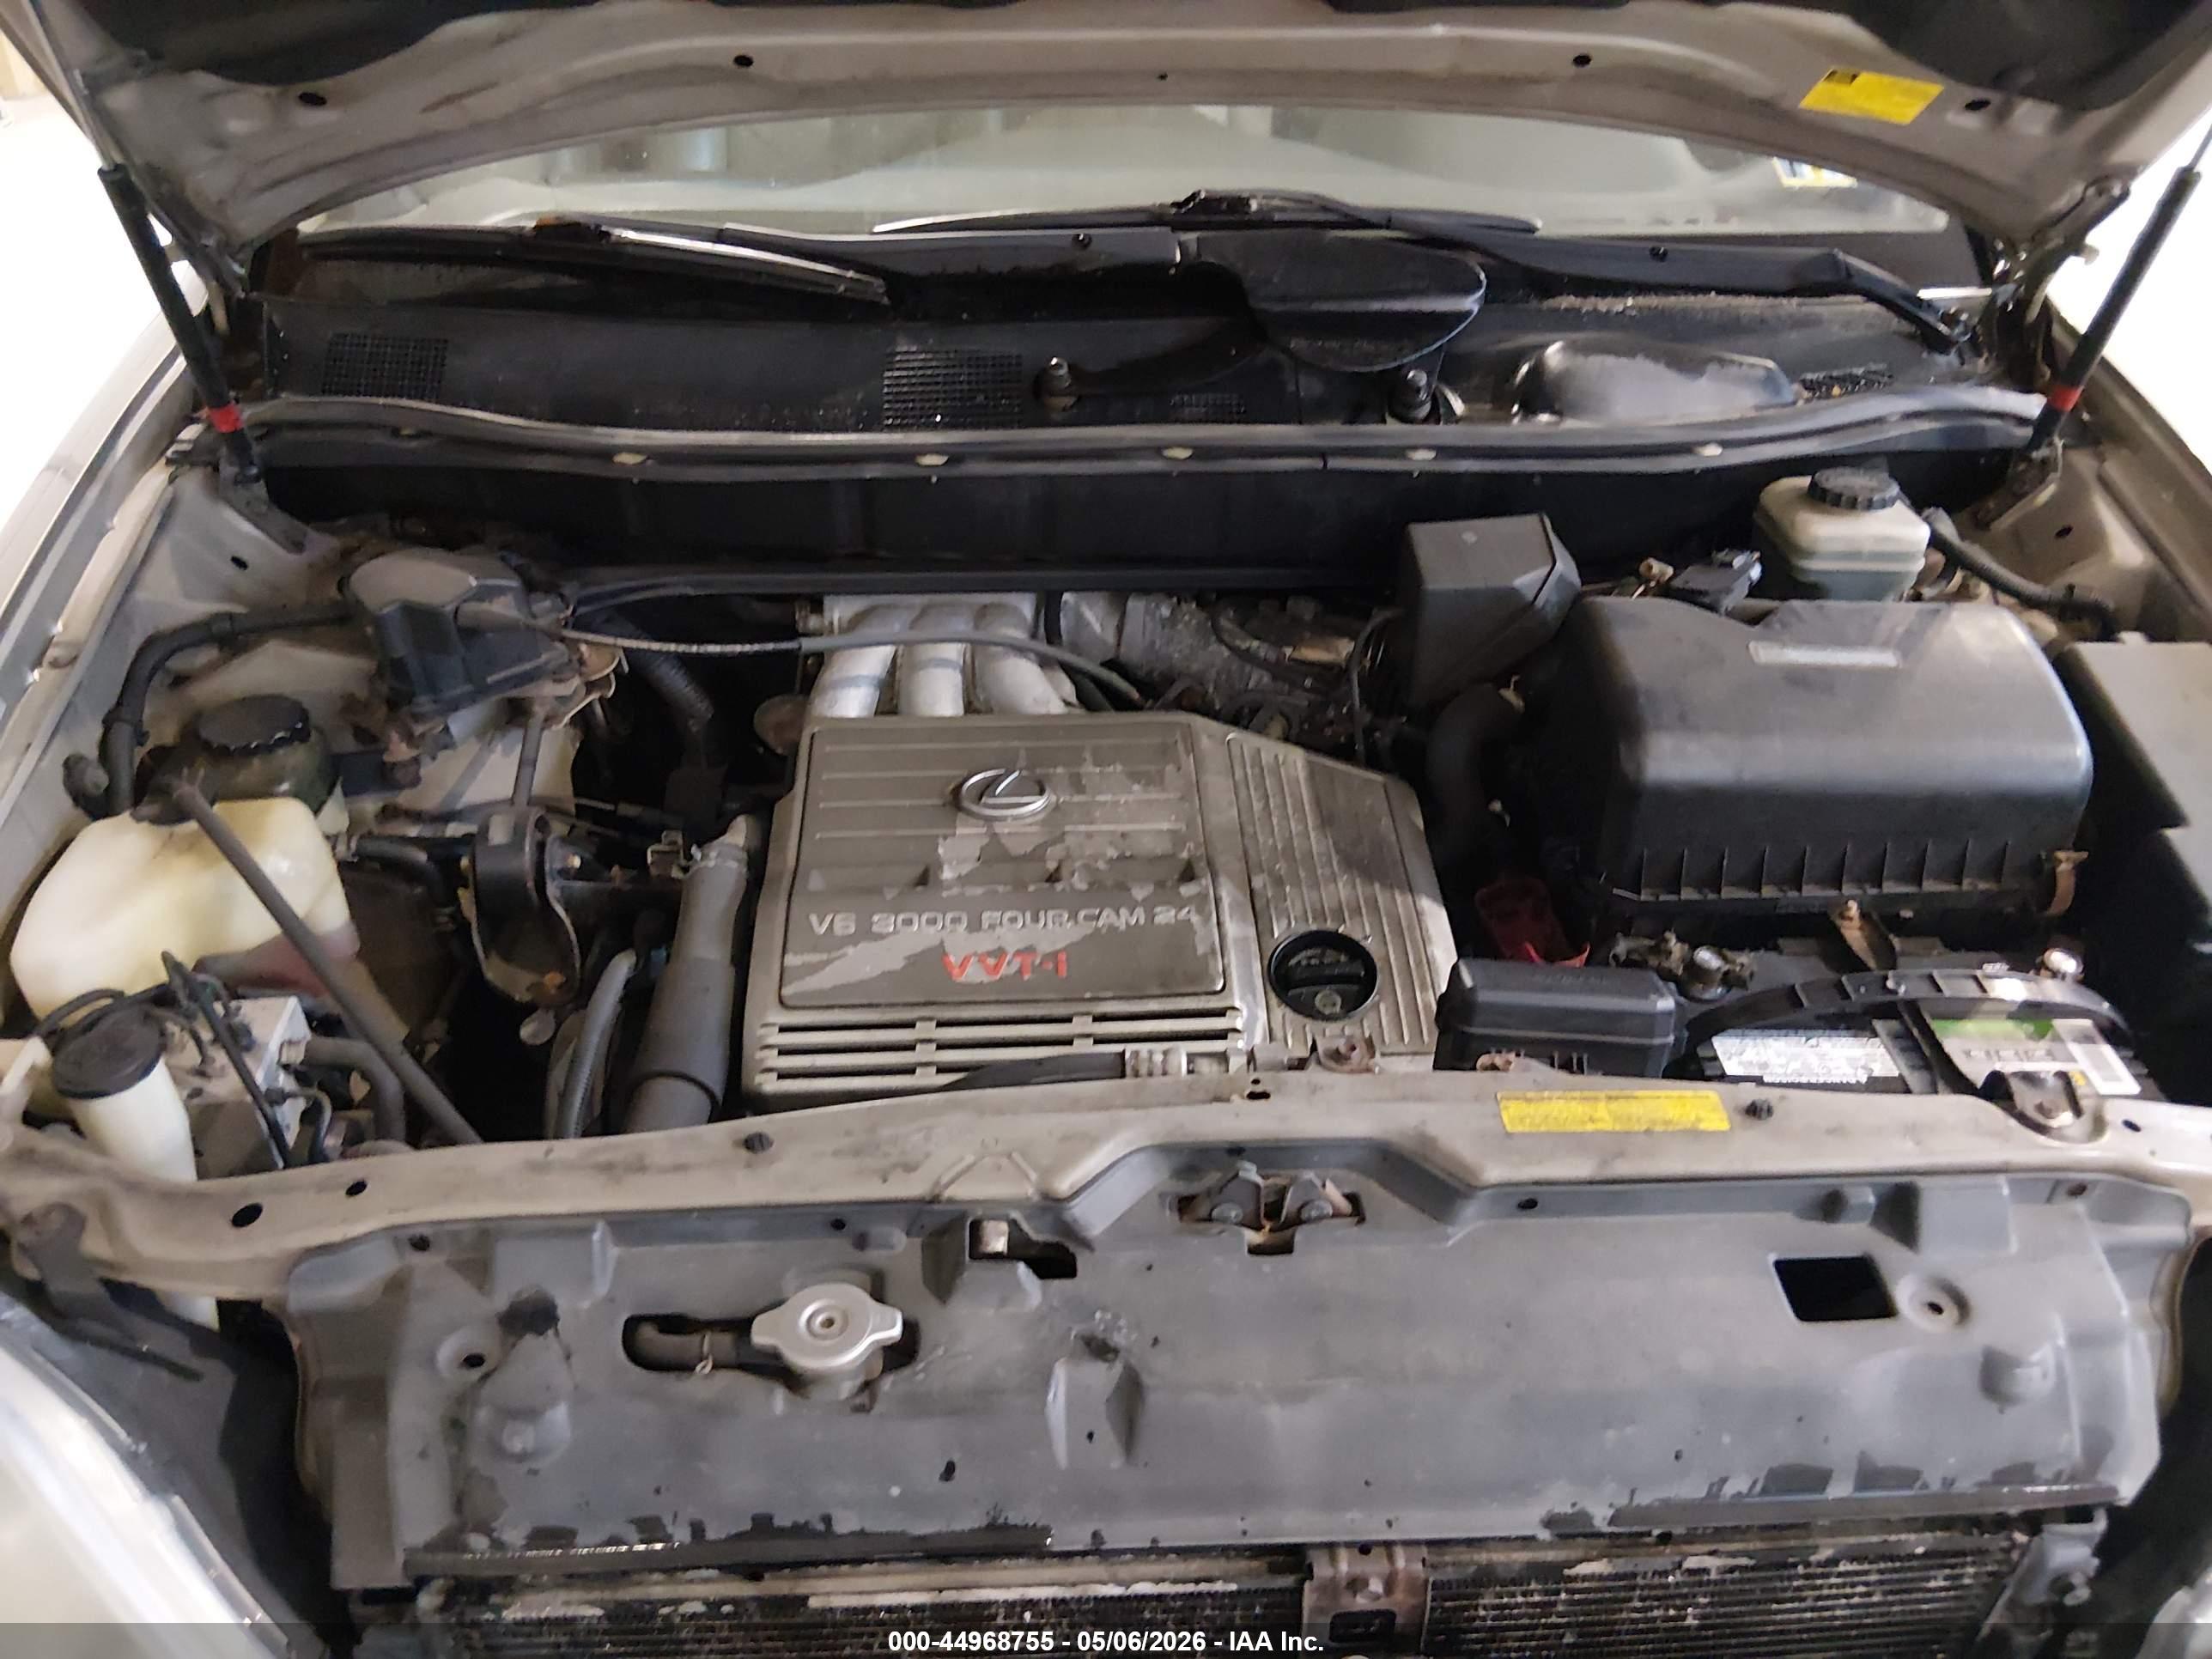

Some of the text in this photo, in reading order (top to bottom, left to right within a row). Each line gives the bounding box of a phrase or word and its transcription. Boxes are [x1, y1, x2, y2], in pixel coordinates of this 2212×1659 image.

[809, 912, 857, 936] V6
[871, 910, 969, 934] 3000
[1077, 905, 1146, 931] CAM
